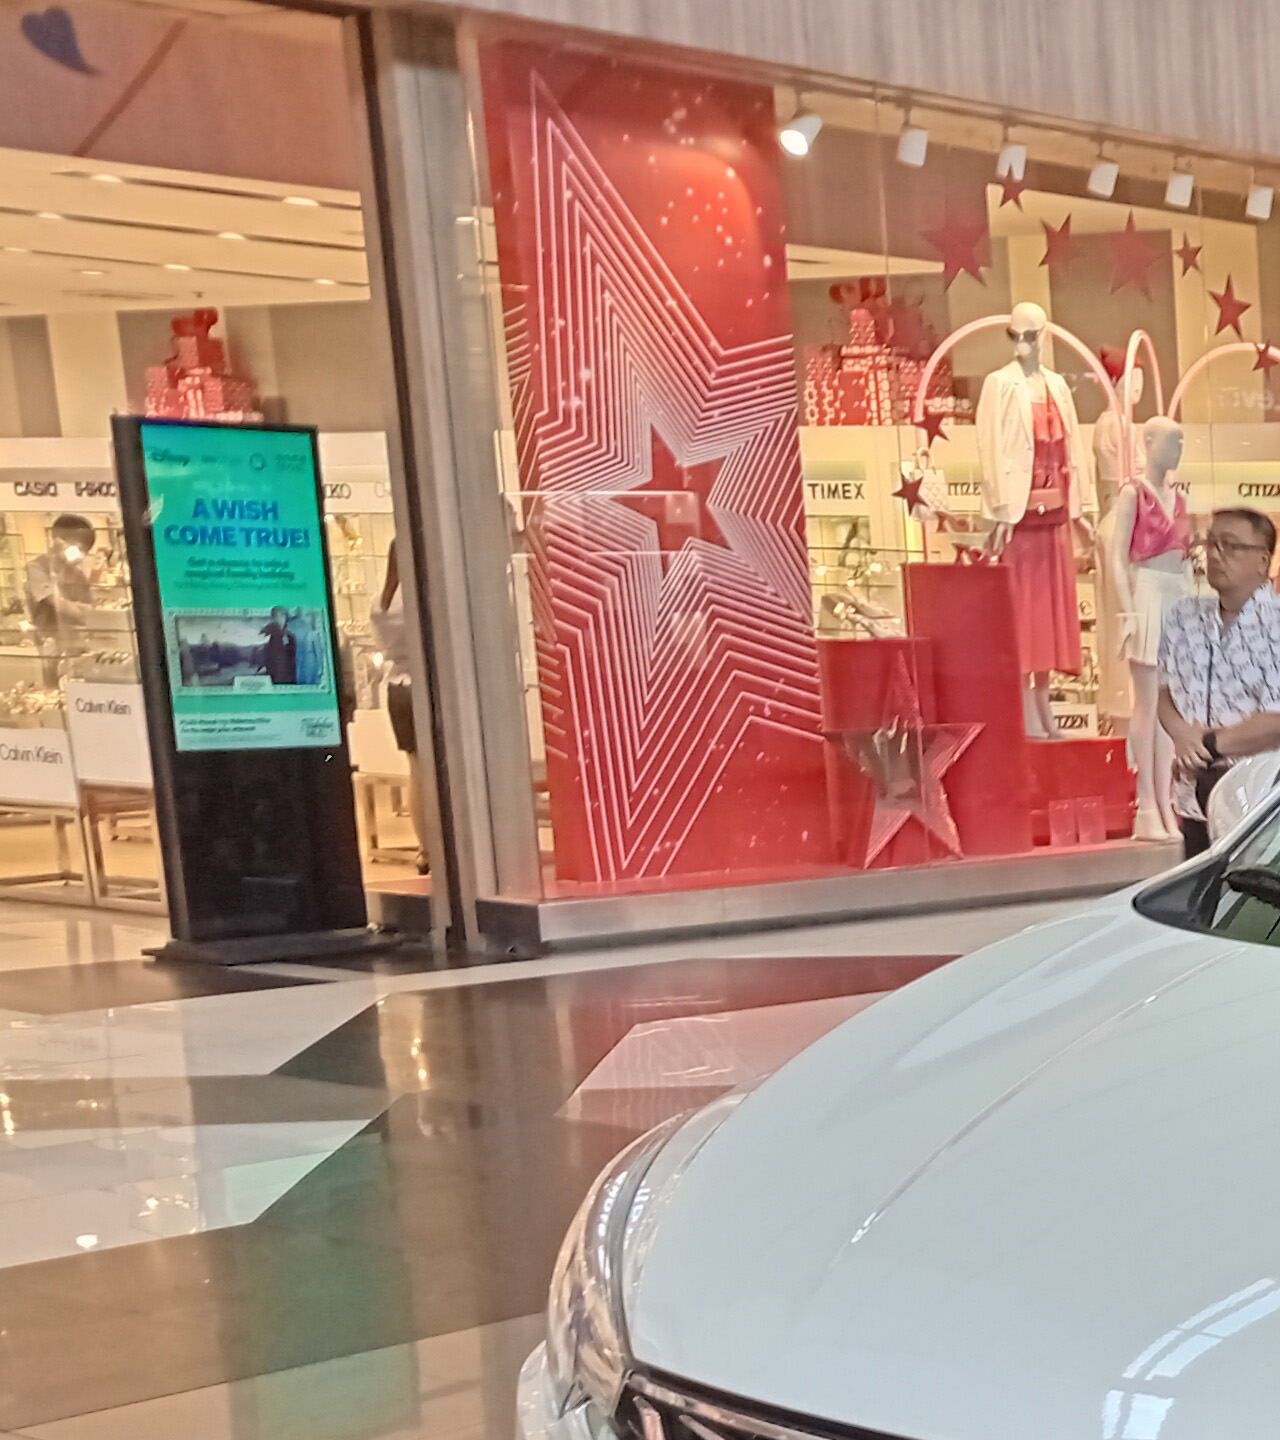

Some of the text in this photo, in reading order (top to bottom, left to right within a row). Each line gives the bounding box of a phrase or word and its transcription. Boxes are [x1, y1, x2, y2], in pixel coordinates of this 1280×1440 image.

[807, 483, 865, 499] TIMEX
[947, 482, 981, 496] ITIZE
[193, 498, 279, 521] A WISH
[164, 524, 311, 549] COME TRUE!
